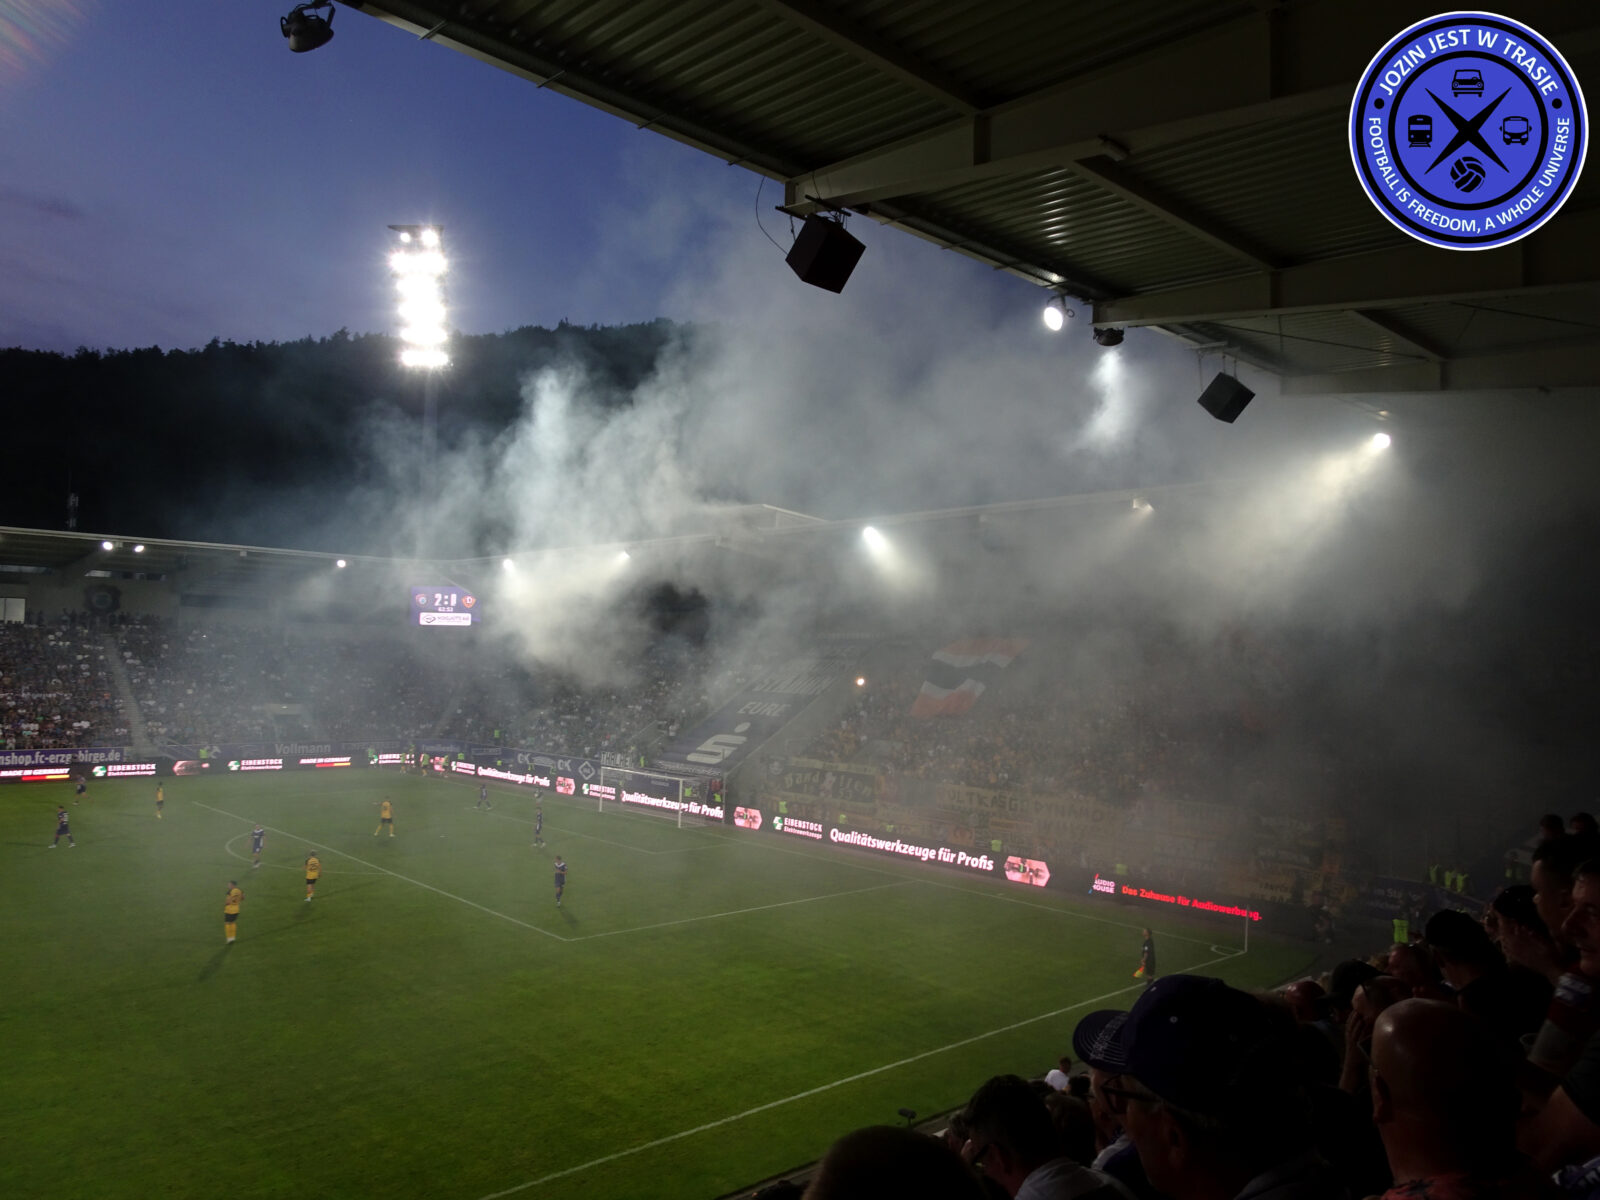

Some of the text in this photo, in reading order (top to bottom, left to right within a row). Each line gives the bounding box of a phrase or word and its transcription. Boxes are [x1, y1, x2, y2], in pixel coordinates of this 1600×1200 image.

[275, 743, 331, 754] Vollmann
[784, 817, 823, 832] EIBENSTOCK
[830, 828, 994, 871] Qualitätswerkzeuge für Profis
[1121, 885, 1138, 896] Das
[1139, 888, 1175, 903] Zuhause
[1176, 895, 1191, 906] für
